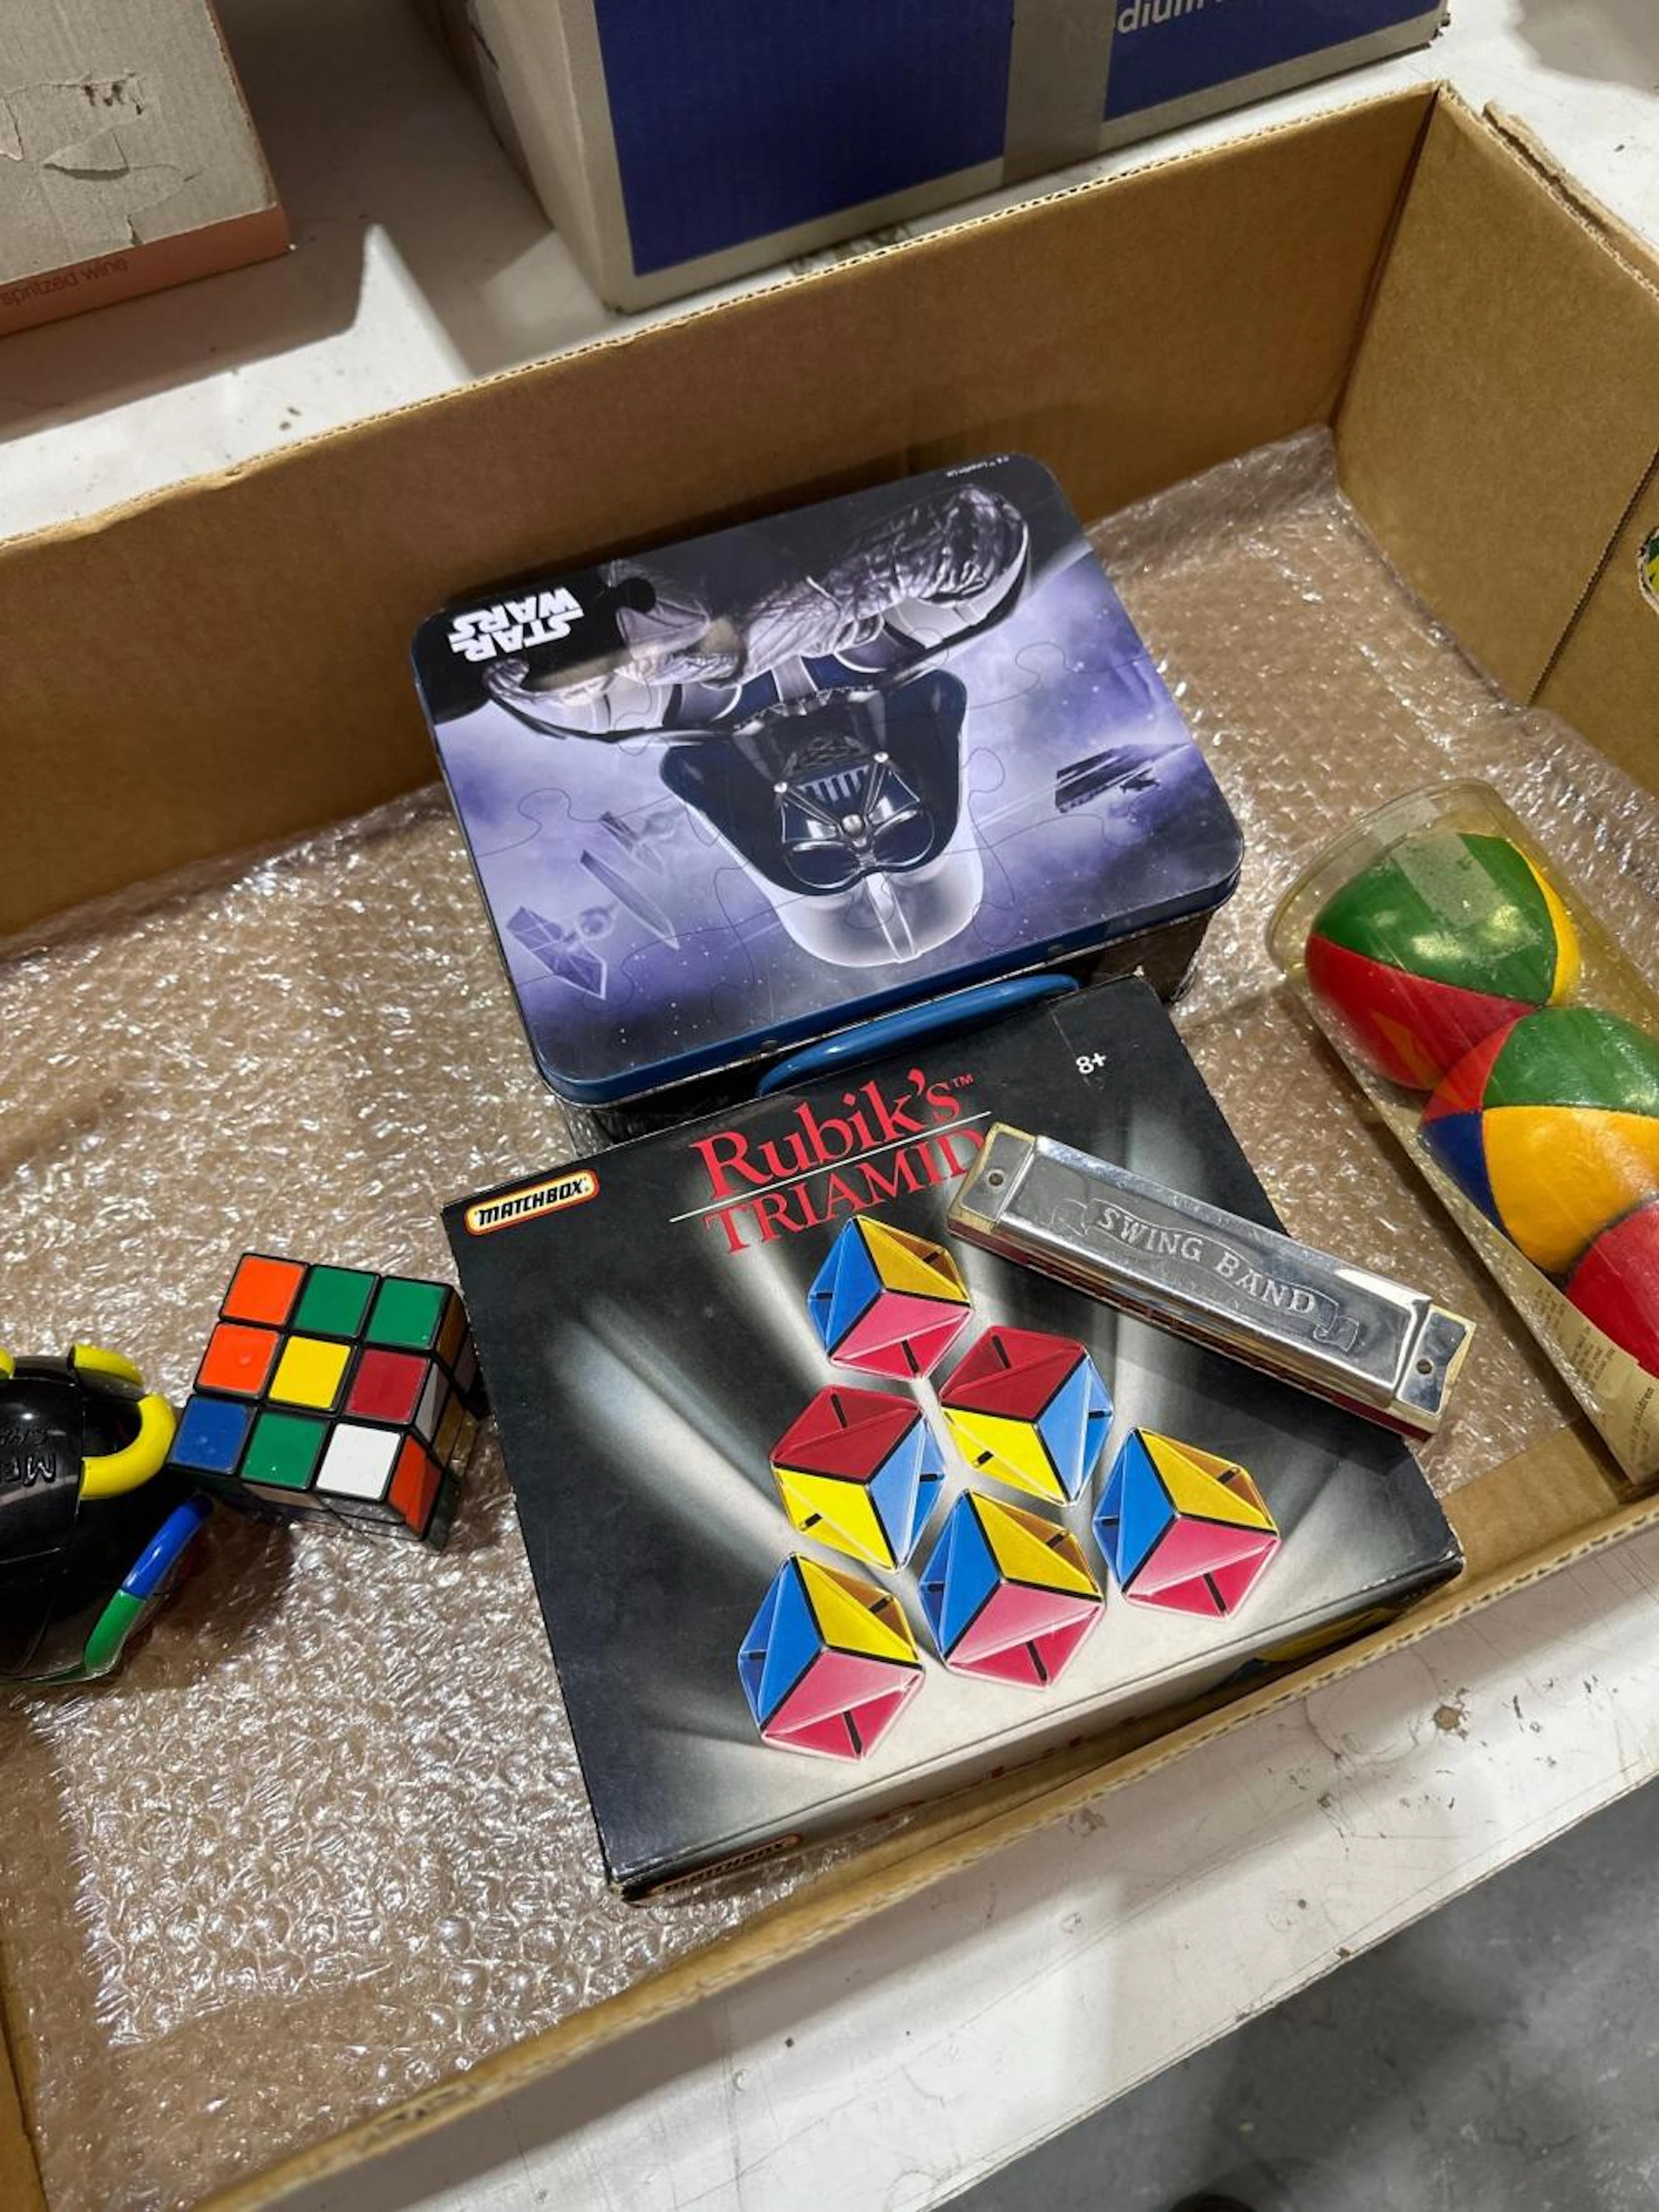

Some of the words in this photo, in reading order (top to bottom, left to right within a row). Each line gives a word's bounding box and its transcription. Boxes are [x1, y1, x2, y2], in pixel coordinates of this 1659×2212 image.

[80, 258, 128, 280] wine
[448, 586, 582, 645] WARS
[450, 607, 585, 662] STAR
[1076, 1053, 1107, 1075] 8+
[479, 1180, 583, 1226] MATCHBOX
[1095, 1207, 1204, 1264] SWING
[1215, 1250, 1316, 1314] BAND
